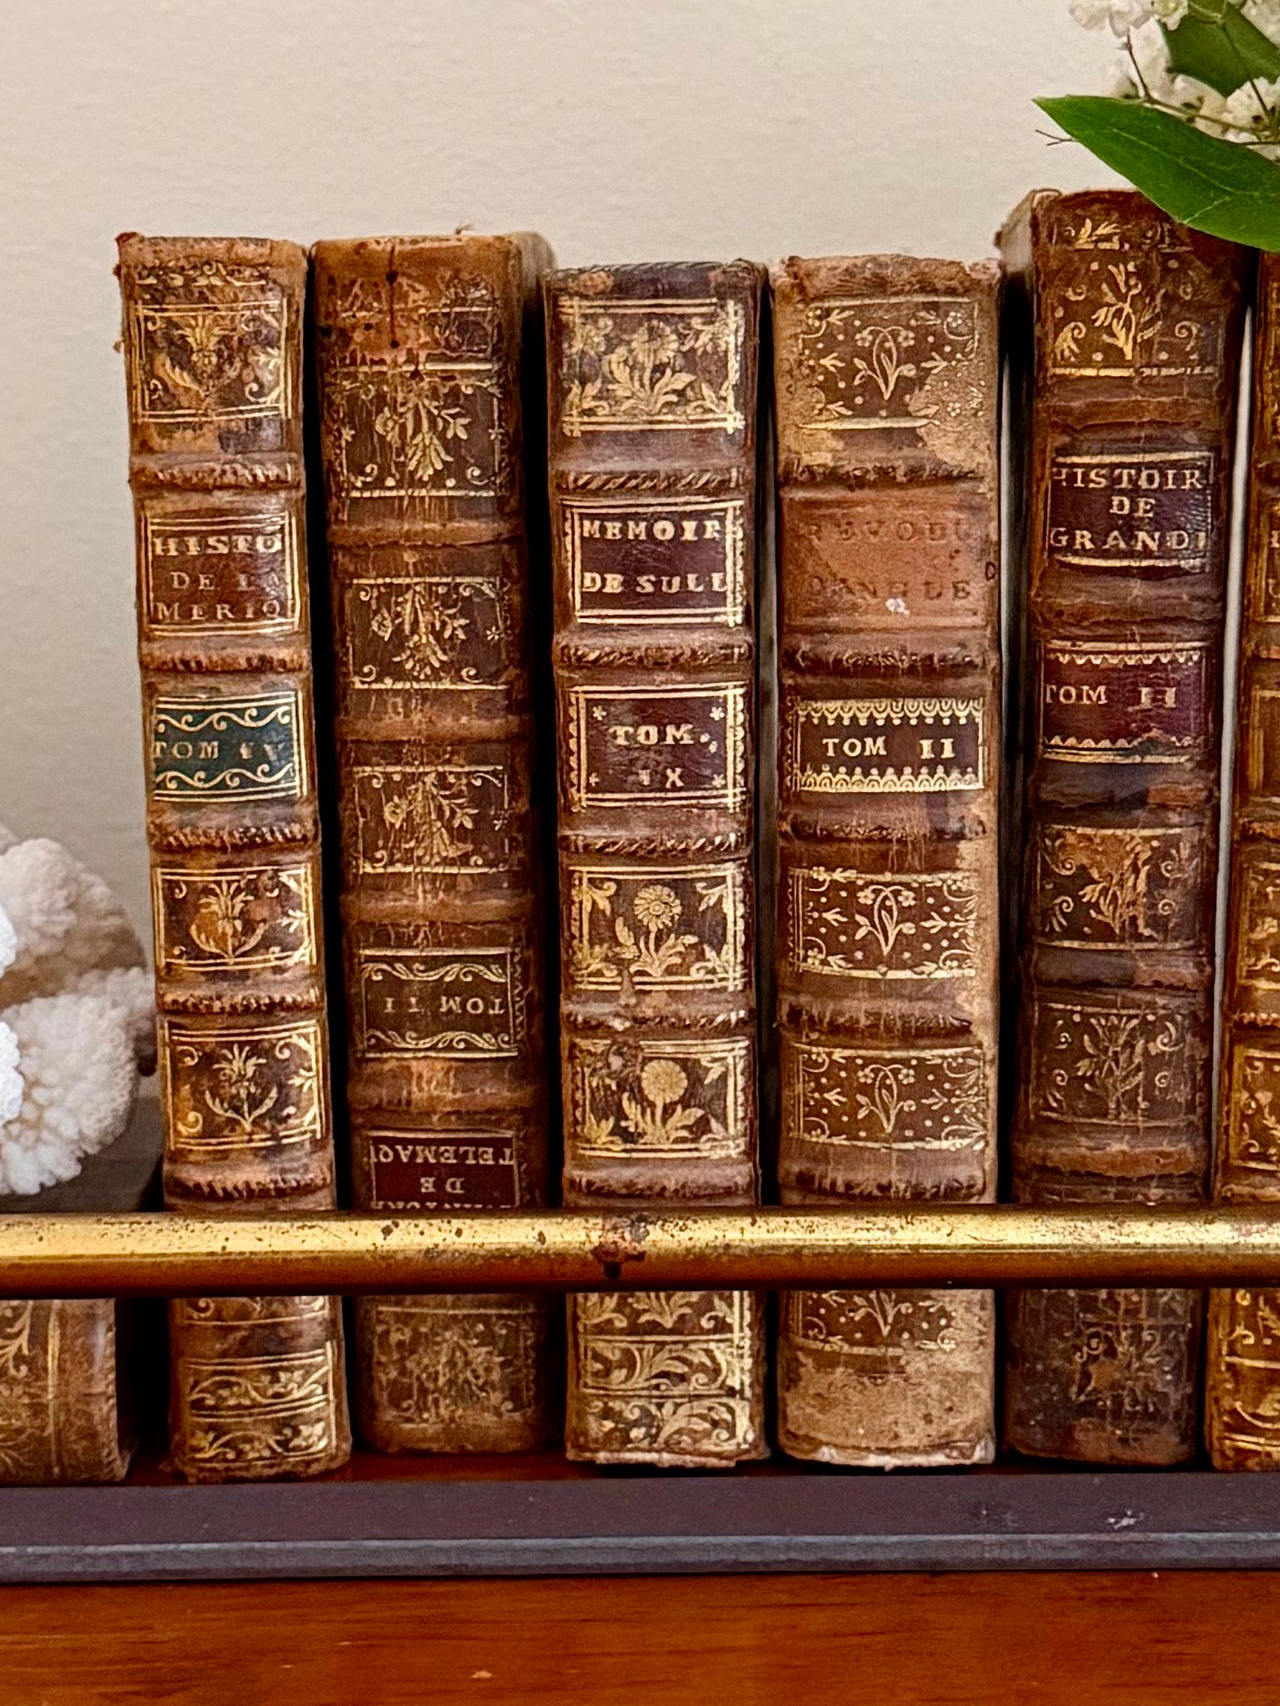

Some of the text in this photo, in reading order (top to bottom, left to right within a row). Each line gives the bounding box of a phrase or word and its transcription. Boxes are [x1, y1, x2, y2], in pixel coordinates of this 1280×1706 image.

[1051, 467, 1207, 490] HISTOIR
[1109, 495, 1156, 518] DE
[582, 519, 723, 541] MEMOIR
[152, 533, 282, 556] HISTO
[171, 571, 216, 591] DE
[582, 572, 728, 594] DE SULL
[1045, 684, 1177, 709] TOM II
[153, 740, 219, 760] TOM
[822, 735, 956, 760] TOM II
[439, 995, 505, 1014] TOM
[419, 1176, 466, 1195] DE
